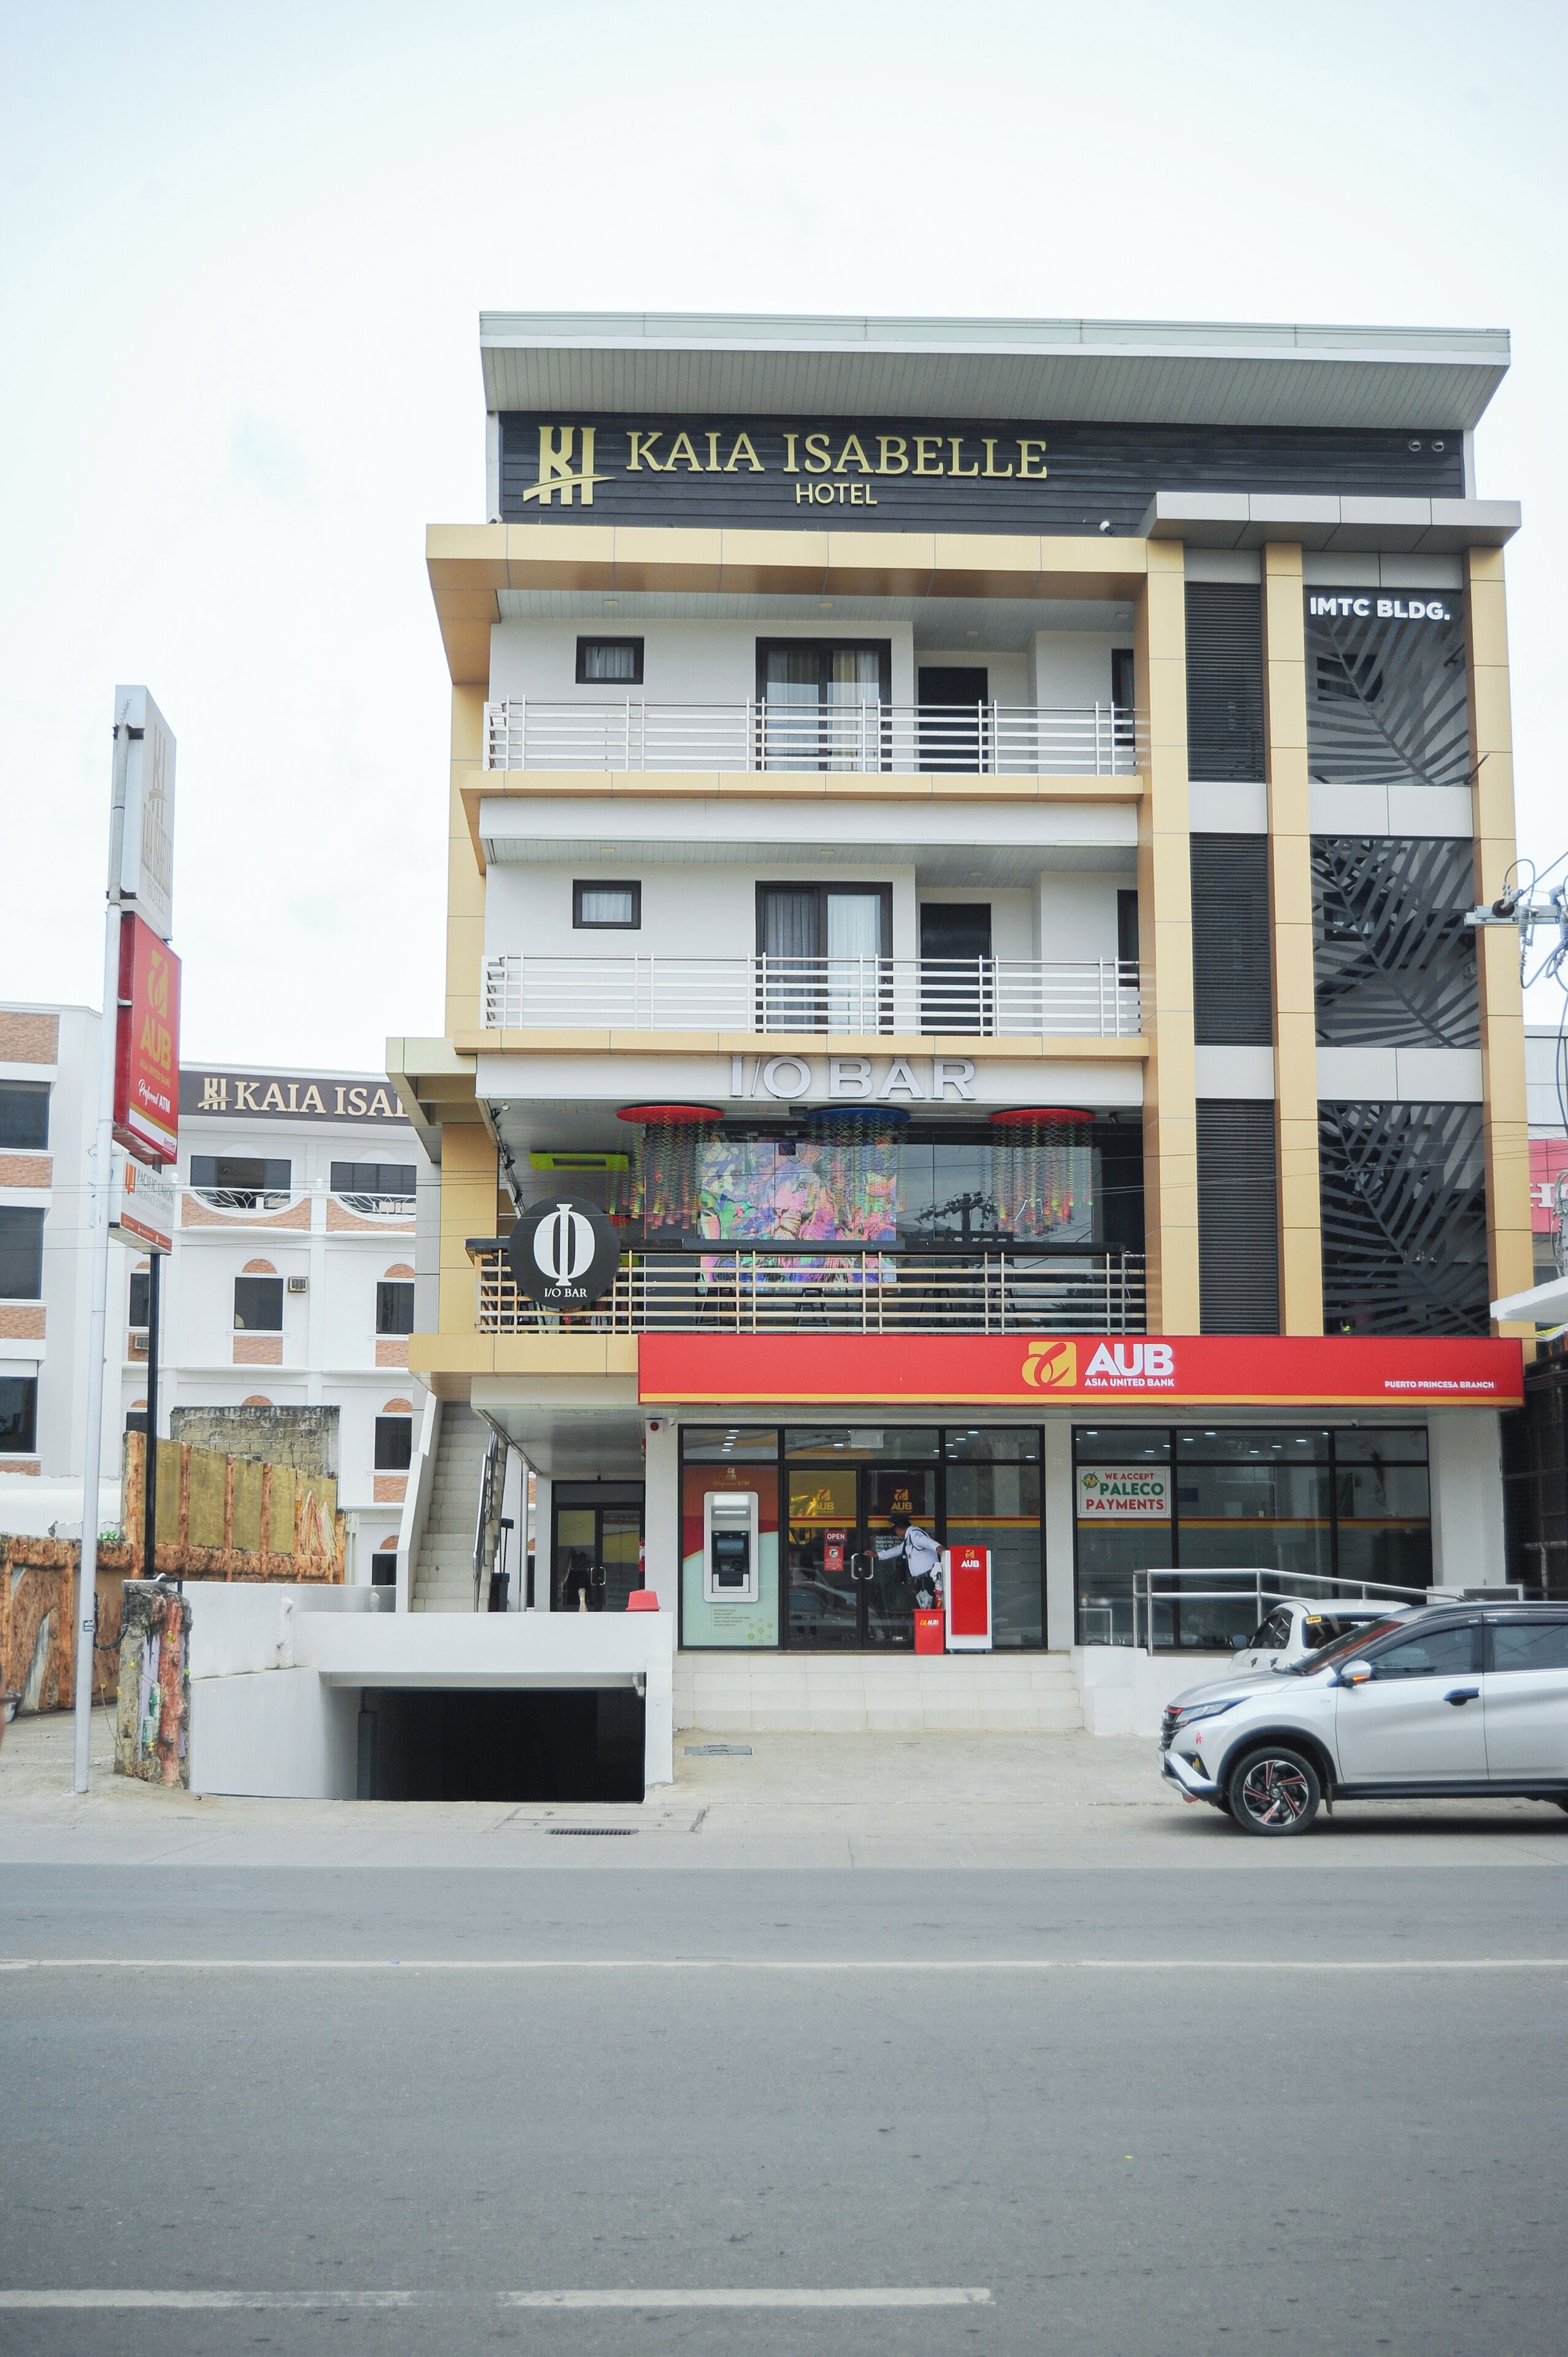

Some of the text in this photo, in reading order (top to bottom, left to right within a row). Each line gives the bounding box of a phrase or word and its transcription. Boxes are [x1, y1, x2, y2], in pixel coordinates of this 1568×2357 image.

[625, 431, 1048, 479] KAIA ISABELLE
[796, 483, 878, 505] HOTEL
[1310, 597, 1450, 621] IMTC BLDG.
[147, 874, 164, 915] HOTEL
[140, 1013, 172, 1072] AUB
[730, 1055, 976, 1100] I/O BAR
[138, 1078, 171, 1115] Preferred ATM
[234, 1081, 326, 1114] KAIA
[137, 1169, 174, 1203] PACIFIC UNION
[544, 1288, 587, 1298] I/O BAR
[1084, 1342, 1174, 1376] AUB
[1084, 1378, 1108, 1387] ASIA
[1110, 1378, 1145, 1387] UNITED
[1100, 1482, 1164, 1496] PALECO
[814, 1502, 834, 1511] AUB
[890, 1501, 913, 1511] AUB
[1086, 1499, 1164, 1510] PAYMENTS
